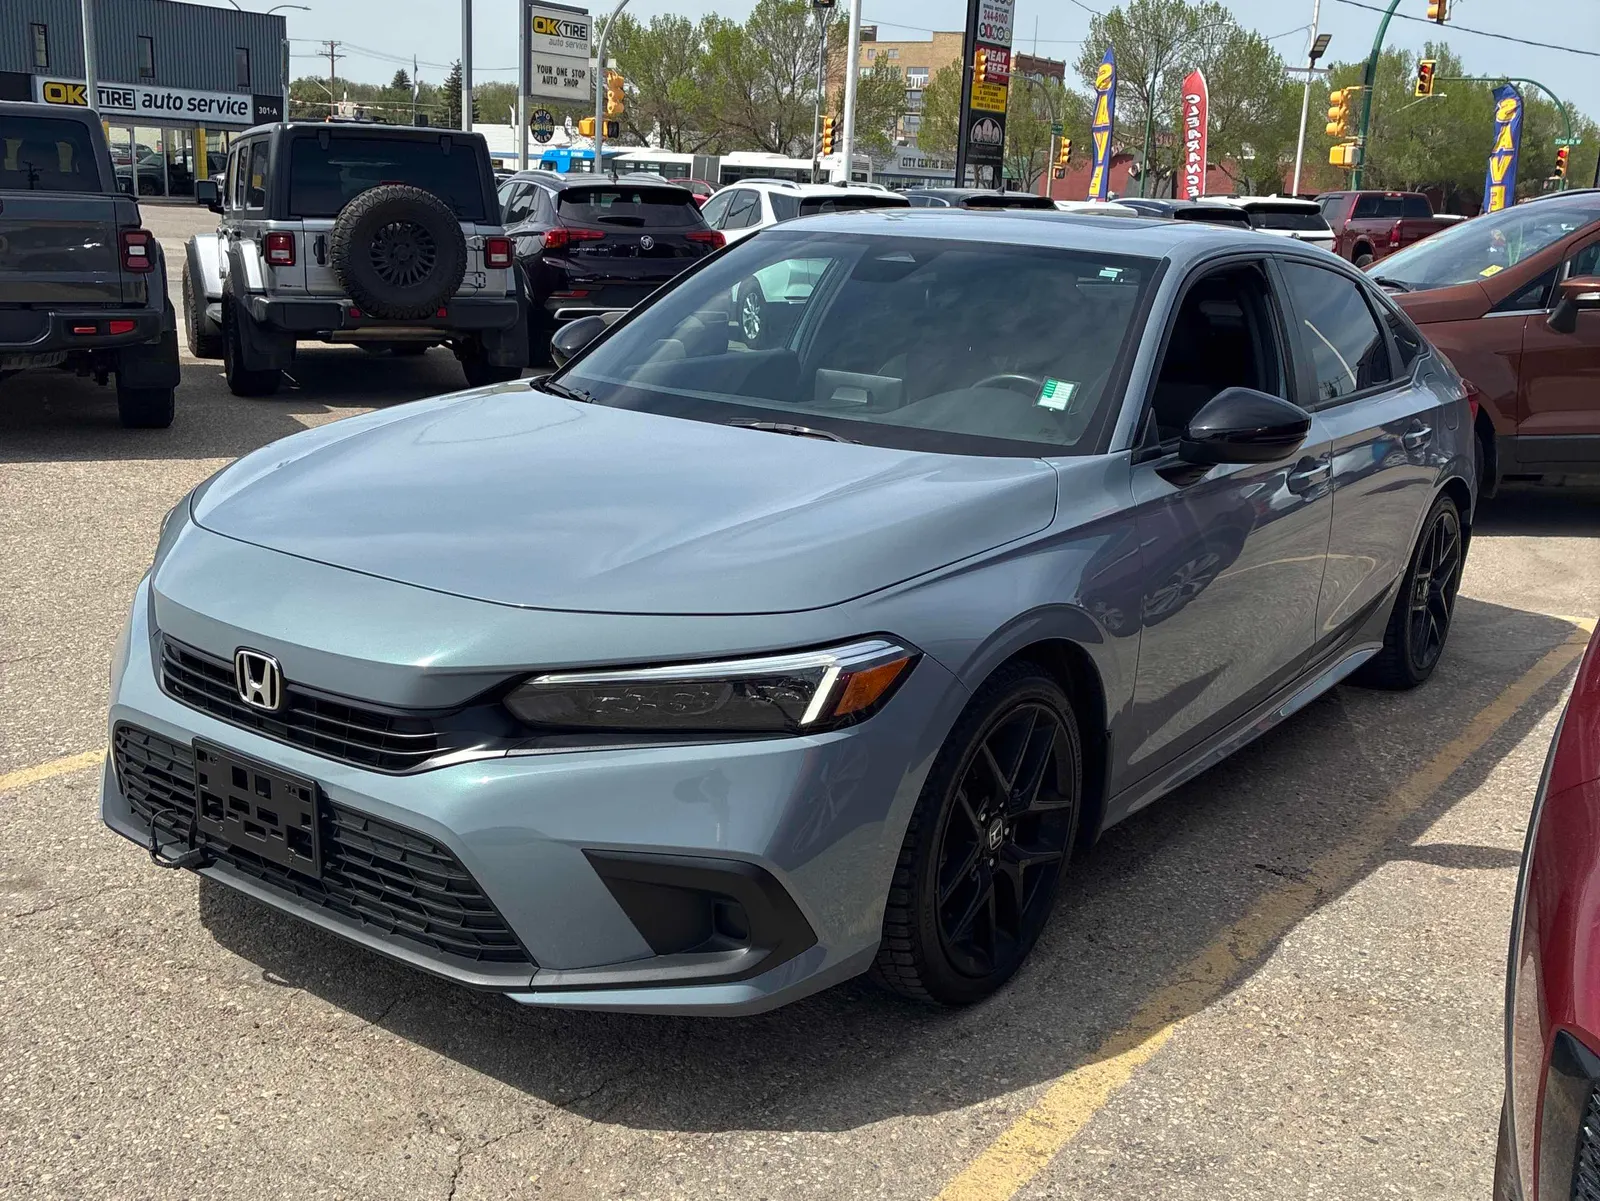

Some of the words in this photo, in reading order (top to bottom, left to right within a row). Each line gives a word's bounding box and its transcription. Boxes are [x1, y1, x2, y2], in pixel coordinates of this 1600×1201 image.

[533, 16, 560, 36] OK
[563, 23, 586, 38] TIRE
[548, 38, 564, 47] auto
[565, 40, 588, 51] service
[537, 64, 553, 75] YOUR
[556, 67, 568, 77] ONE
[571, 69, 586, 79] STOP
[541, 75, 558, 85] AUTO
[563, 77, 579, 88] SHOP
[43, 81, 87, 106] OK
[97, 90, 133, 107] TIRE
[142, 93, 184, 110] auto
[187, 96, 248, 116] service
[258, 106, 278, 116] 301-A
[535, 110, 551, 120] AUTO
[533, 132, 551, 142] SALES
[902, 157, 917, 168] CITY
